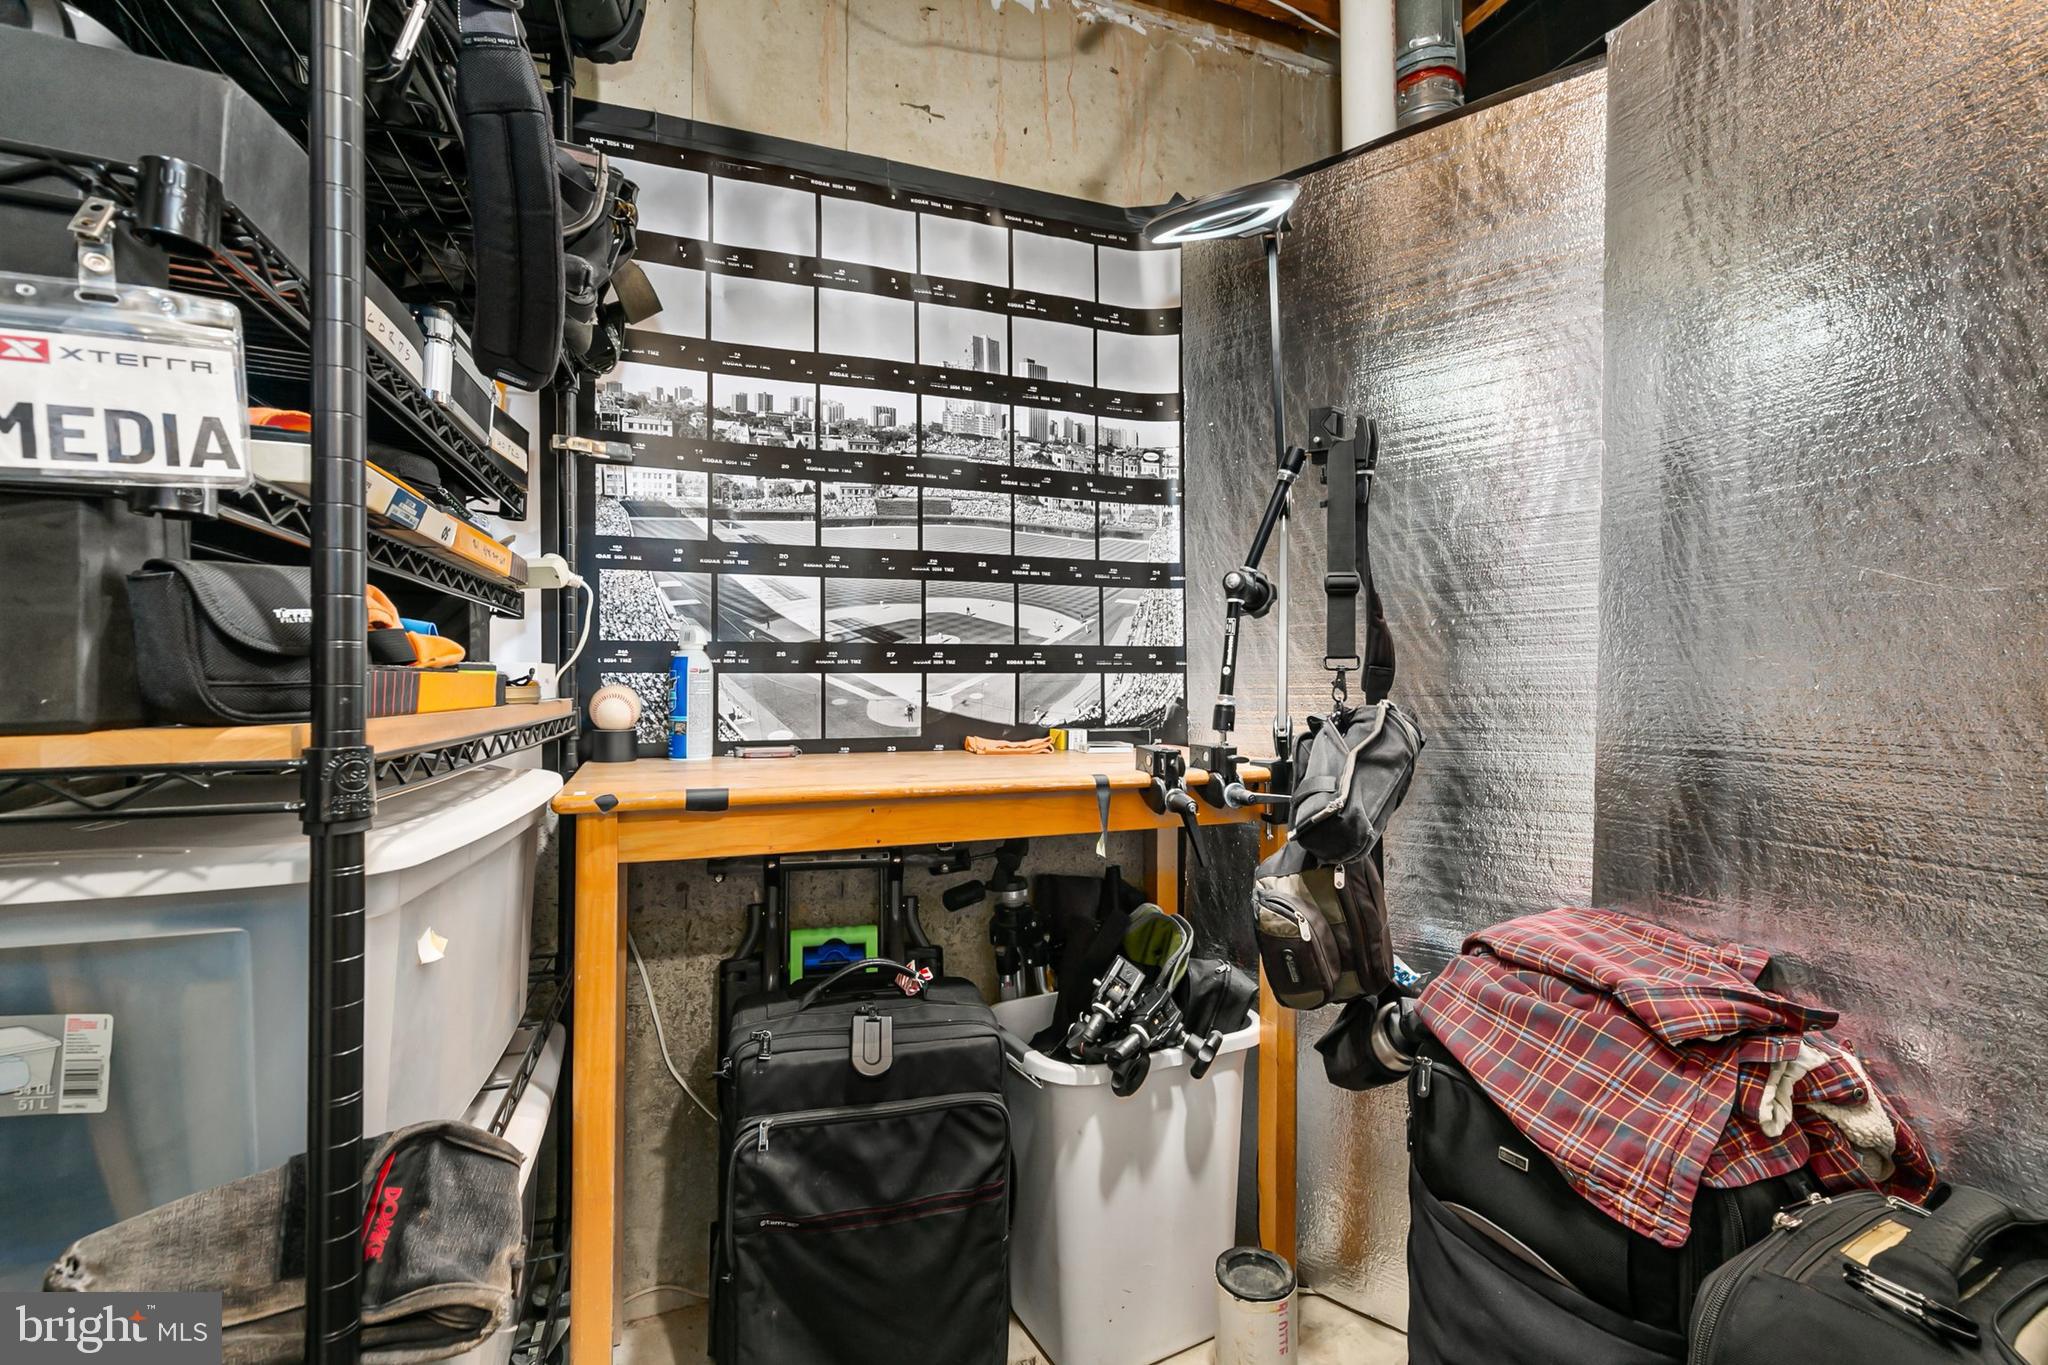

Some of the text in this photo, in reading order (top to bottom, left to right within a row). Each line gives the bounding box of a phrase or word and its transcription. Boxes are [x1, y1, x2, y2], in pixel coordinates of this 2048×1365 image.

[811, 179, 830, 187] KODAK
[60, 346, 213, 374] XTERRA
[0, 402, 242, 470] MEDIA
[272, 607, 312, 619] TIFFE
[364, 1186, 404, 1264] DOMKE
